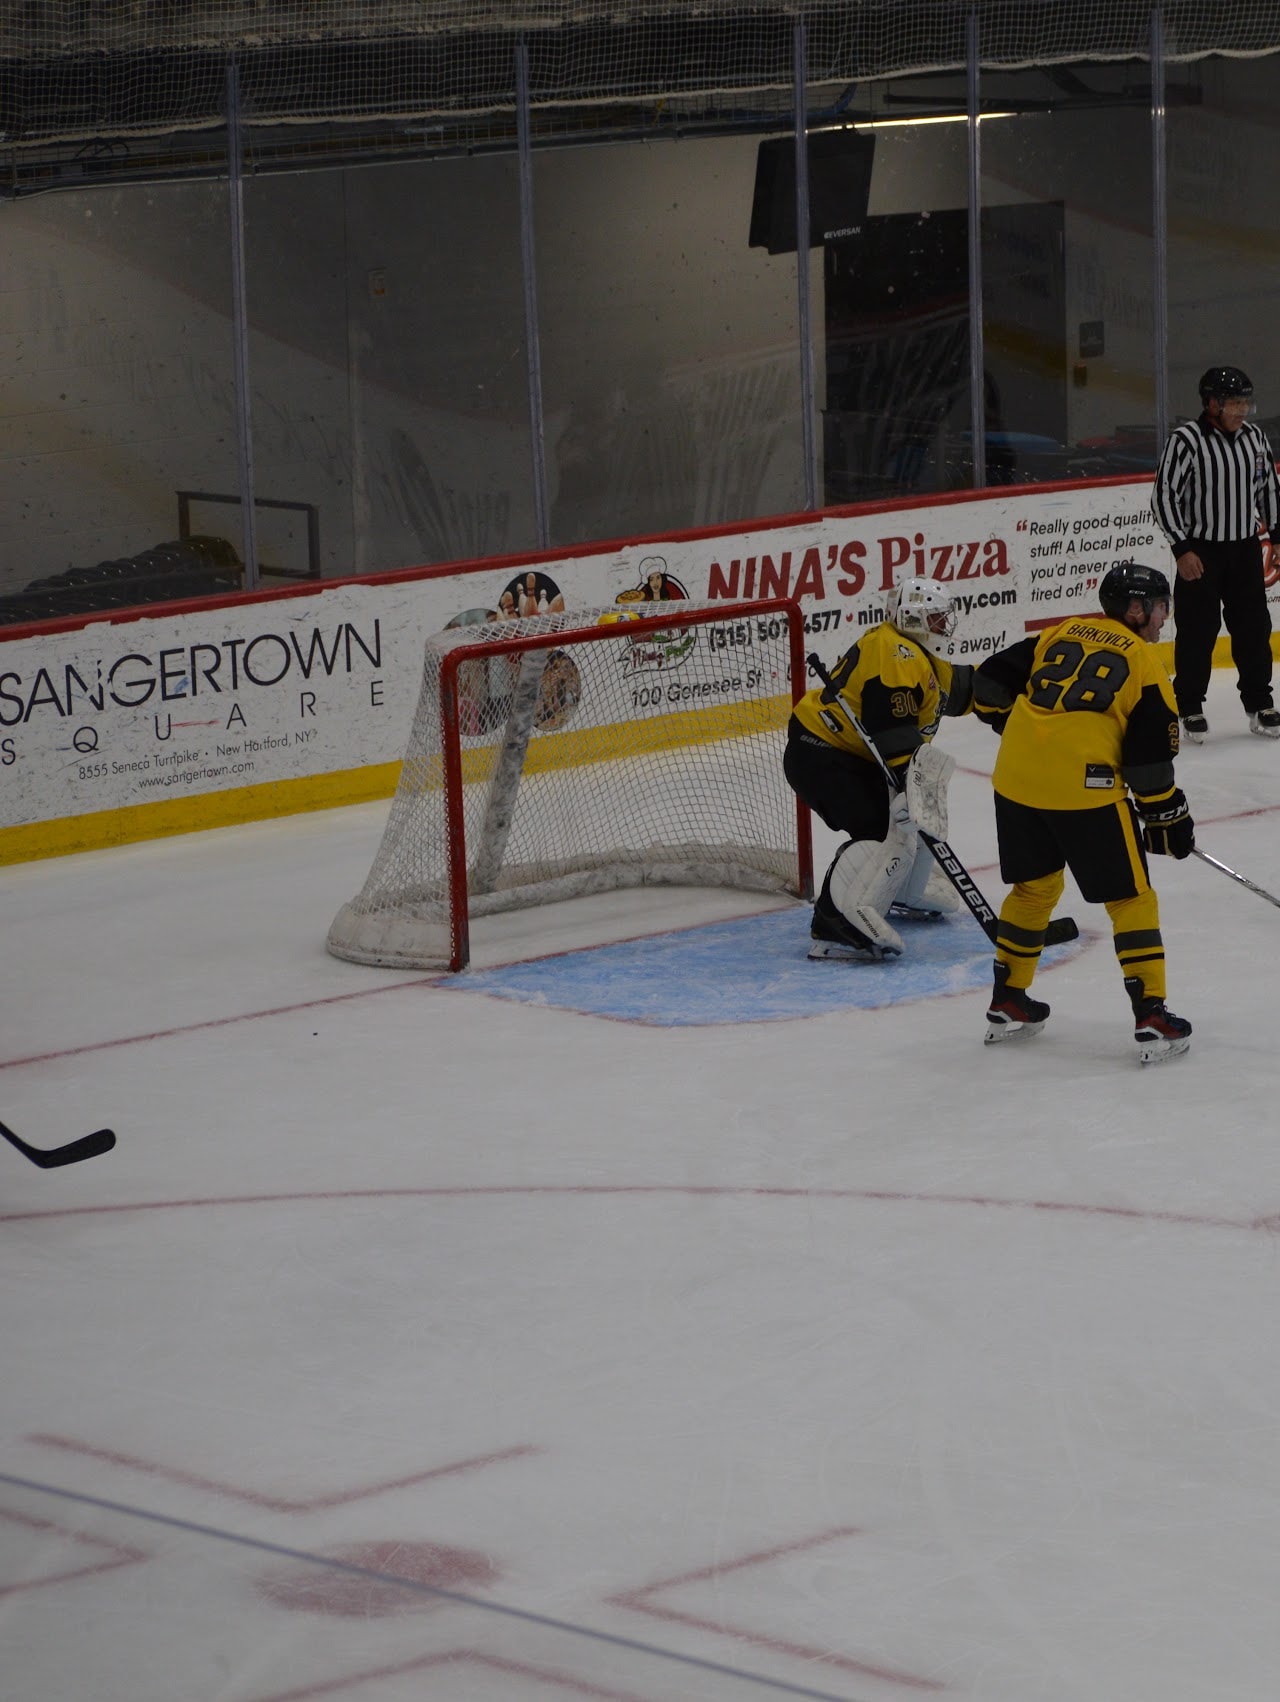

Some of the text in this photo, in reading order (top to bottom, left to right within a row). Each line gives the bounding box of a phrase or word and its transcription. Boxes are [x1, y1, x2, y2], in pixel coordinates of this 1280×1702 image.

[1073, 515, 1110, 534] good
[1113, 511, 1158, 532] quality
[1030, 534, 1154, 558] stuff! A local place
[707, 533, 1010, 601] NINA'S Pizza
[1031, 564, 1067, 583] you'd
[1070, 560, 1108, 576] never
[1031, 583, 1062, 601] tired
[960, 630, 1006, 655] away!
[1067, 623, 1134, 651] BARKOVICH
[0, 618, 382, 728] SANGERTOWN
[1029, 640, 1130, 713] 28
[632, 686, 661, 707] 100
[667, 678, 742, 703] Genesee
[79, 730, 312, 781] 8555 Seneca Turnpike New Hartford, NY
[139, 763, 255, 788] www.sangertown.com
[931, 842, 995, 923] BAUER
